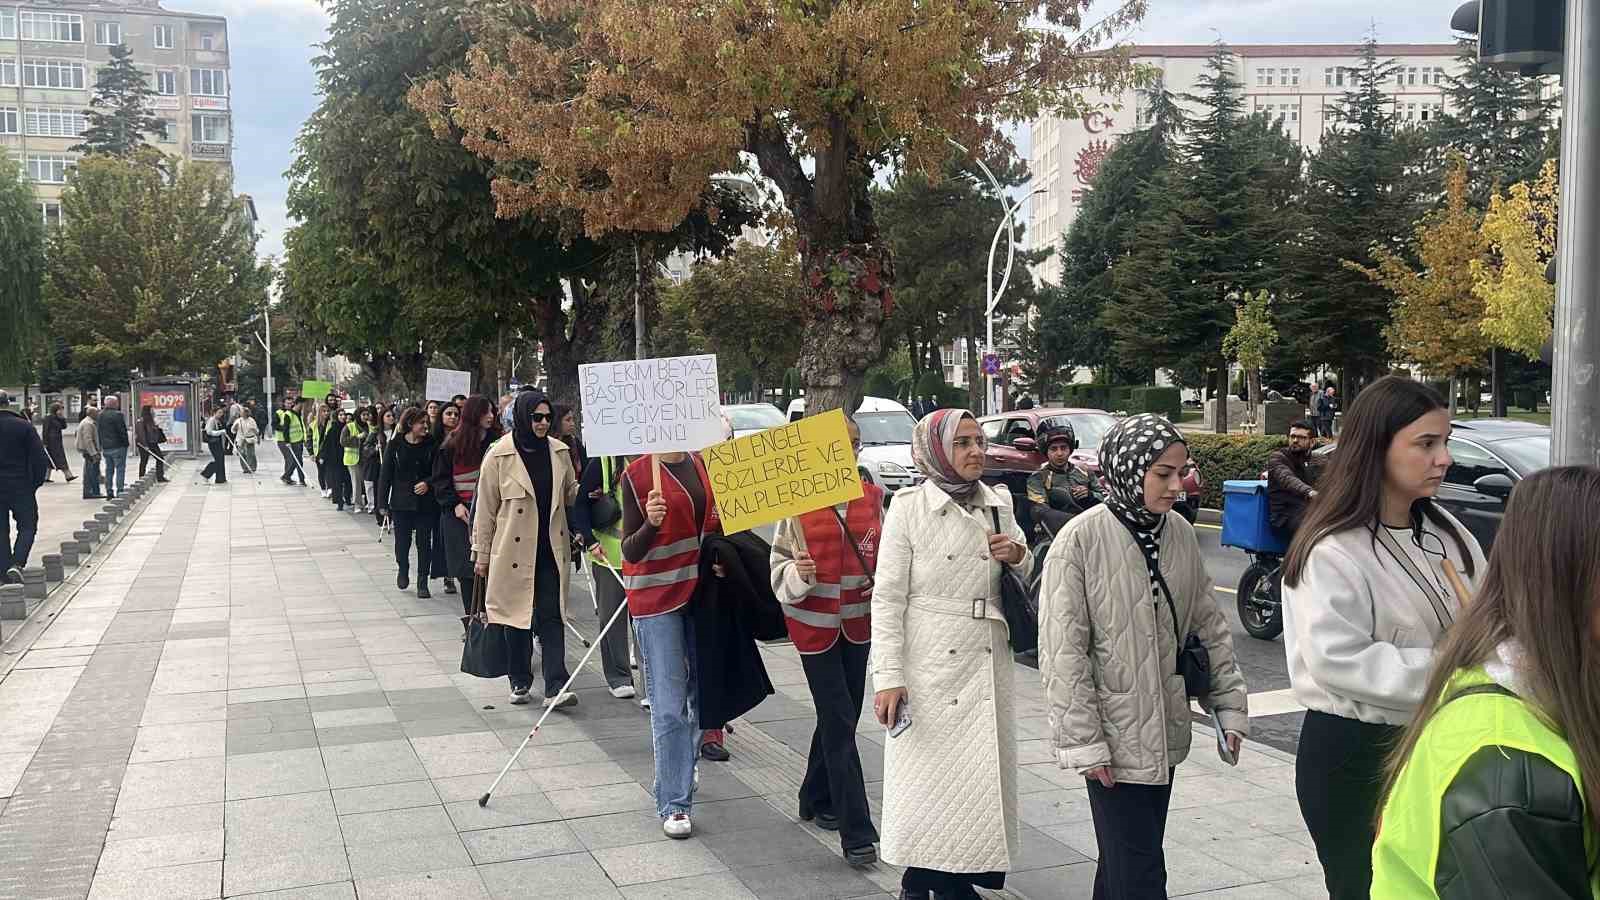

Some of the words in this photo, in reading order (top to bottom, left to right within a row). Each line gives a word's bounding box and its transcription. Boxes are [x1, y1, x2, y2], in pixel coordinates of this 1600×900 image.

[583, 366, 599, 385] 15
[657, 358, 716, 380] BEYAZ
[584, 383, 646, 406] BASTON
[587, 407, 617, 425] VE
[750, 423, 811, 459] ENGEL
[816, 439, 846, 464] VE
